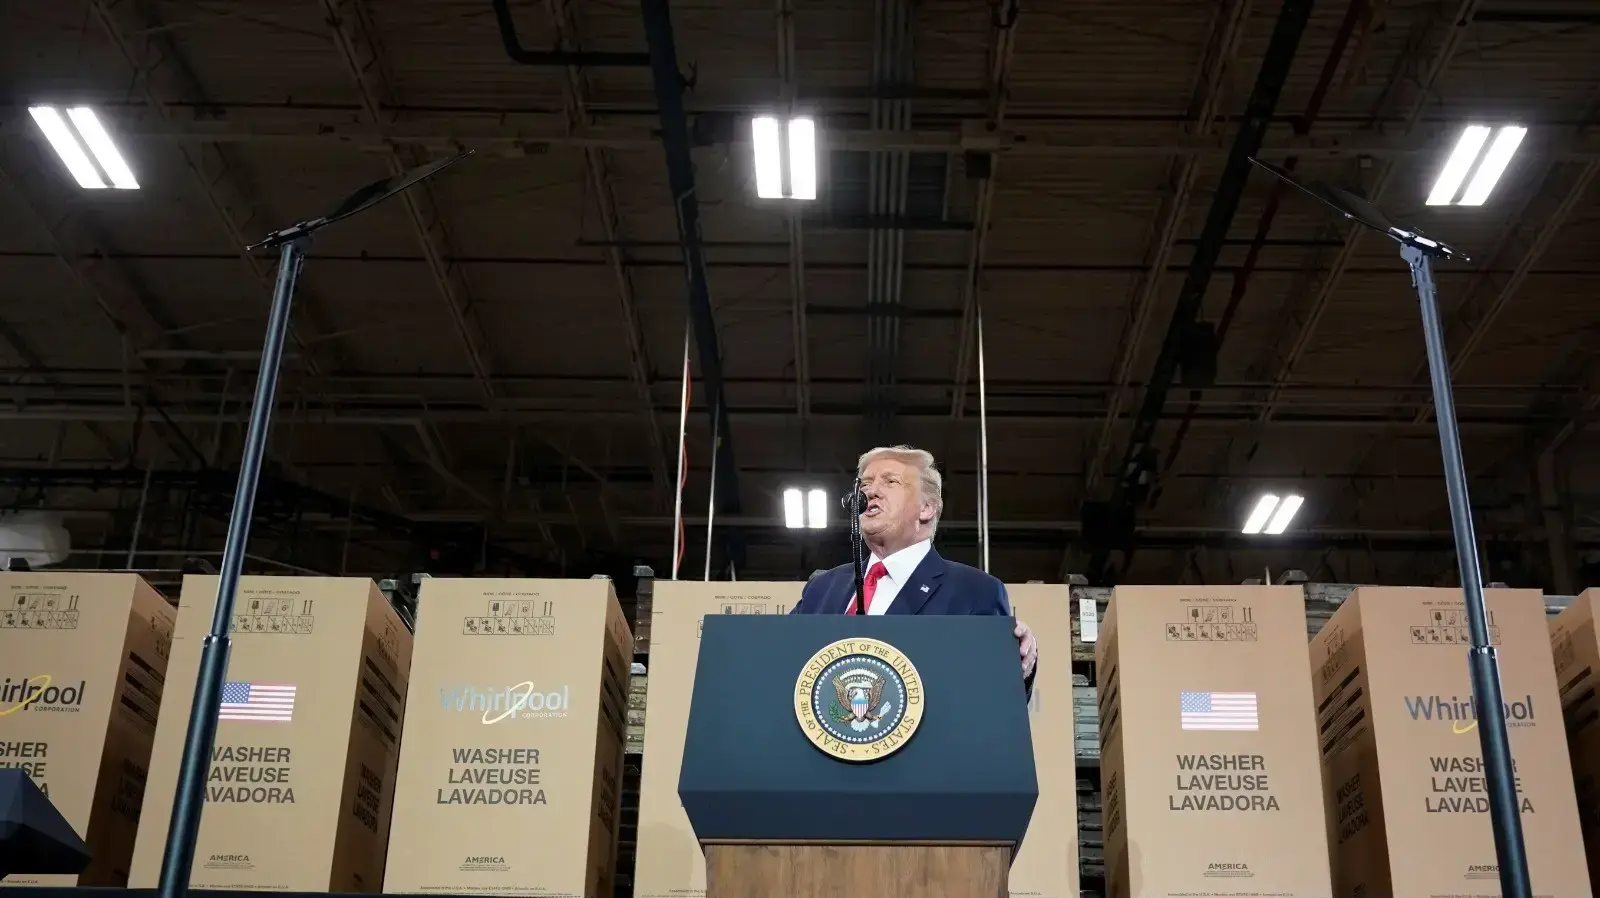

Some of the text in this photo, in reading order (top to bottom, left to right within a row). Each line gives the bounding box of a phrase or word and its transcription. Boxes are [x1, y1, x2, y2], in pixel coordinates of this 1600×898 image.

[0, 677, 86, 711] irlpool
[440, 684, 570, 719] Whirlpool
[800, 643, 920, 755] SEAL OF THE PRESIDENT OF THE UNITED STATES
[34, 705, 81, 713] CORPORATION
[1404, 695, 1535, 720] Whirlol
[212, 746, 291, 762] ASHER
[452, 748, 540, 764] WASHER
[1176, 754, 1265, 770] WASHER
[1430, 757, 1518, 773] WASH
[209, 766, 290, 783] AVEUSE
[448, 768, 541, 785] LAVEUSE
[1176, 775, 1269, 790] LAVEUSE
[204, 786, 296, 803] VADORA
[436, 788, 548, 805] LAVADORA
[1168, 795, 1280, 811] LAVADORA
[1425, 797, 1536, 813] LAVADA
[209, 854, 250, 862] AMERICA
[465, 856, 505, 864] AMERICA
